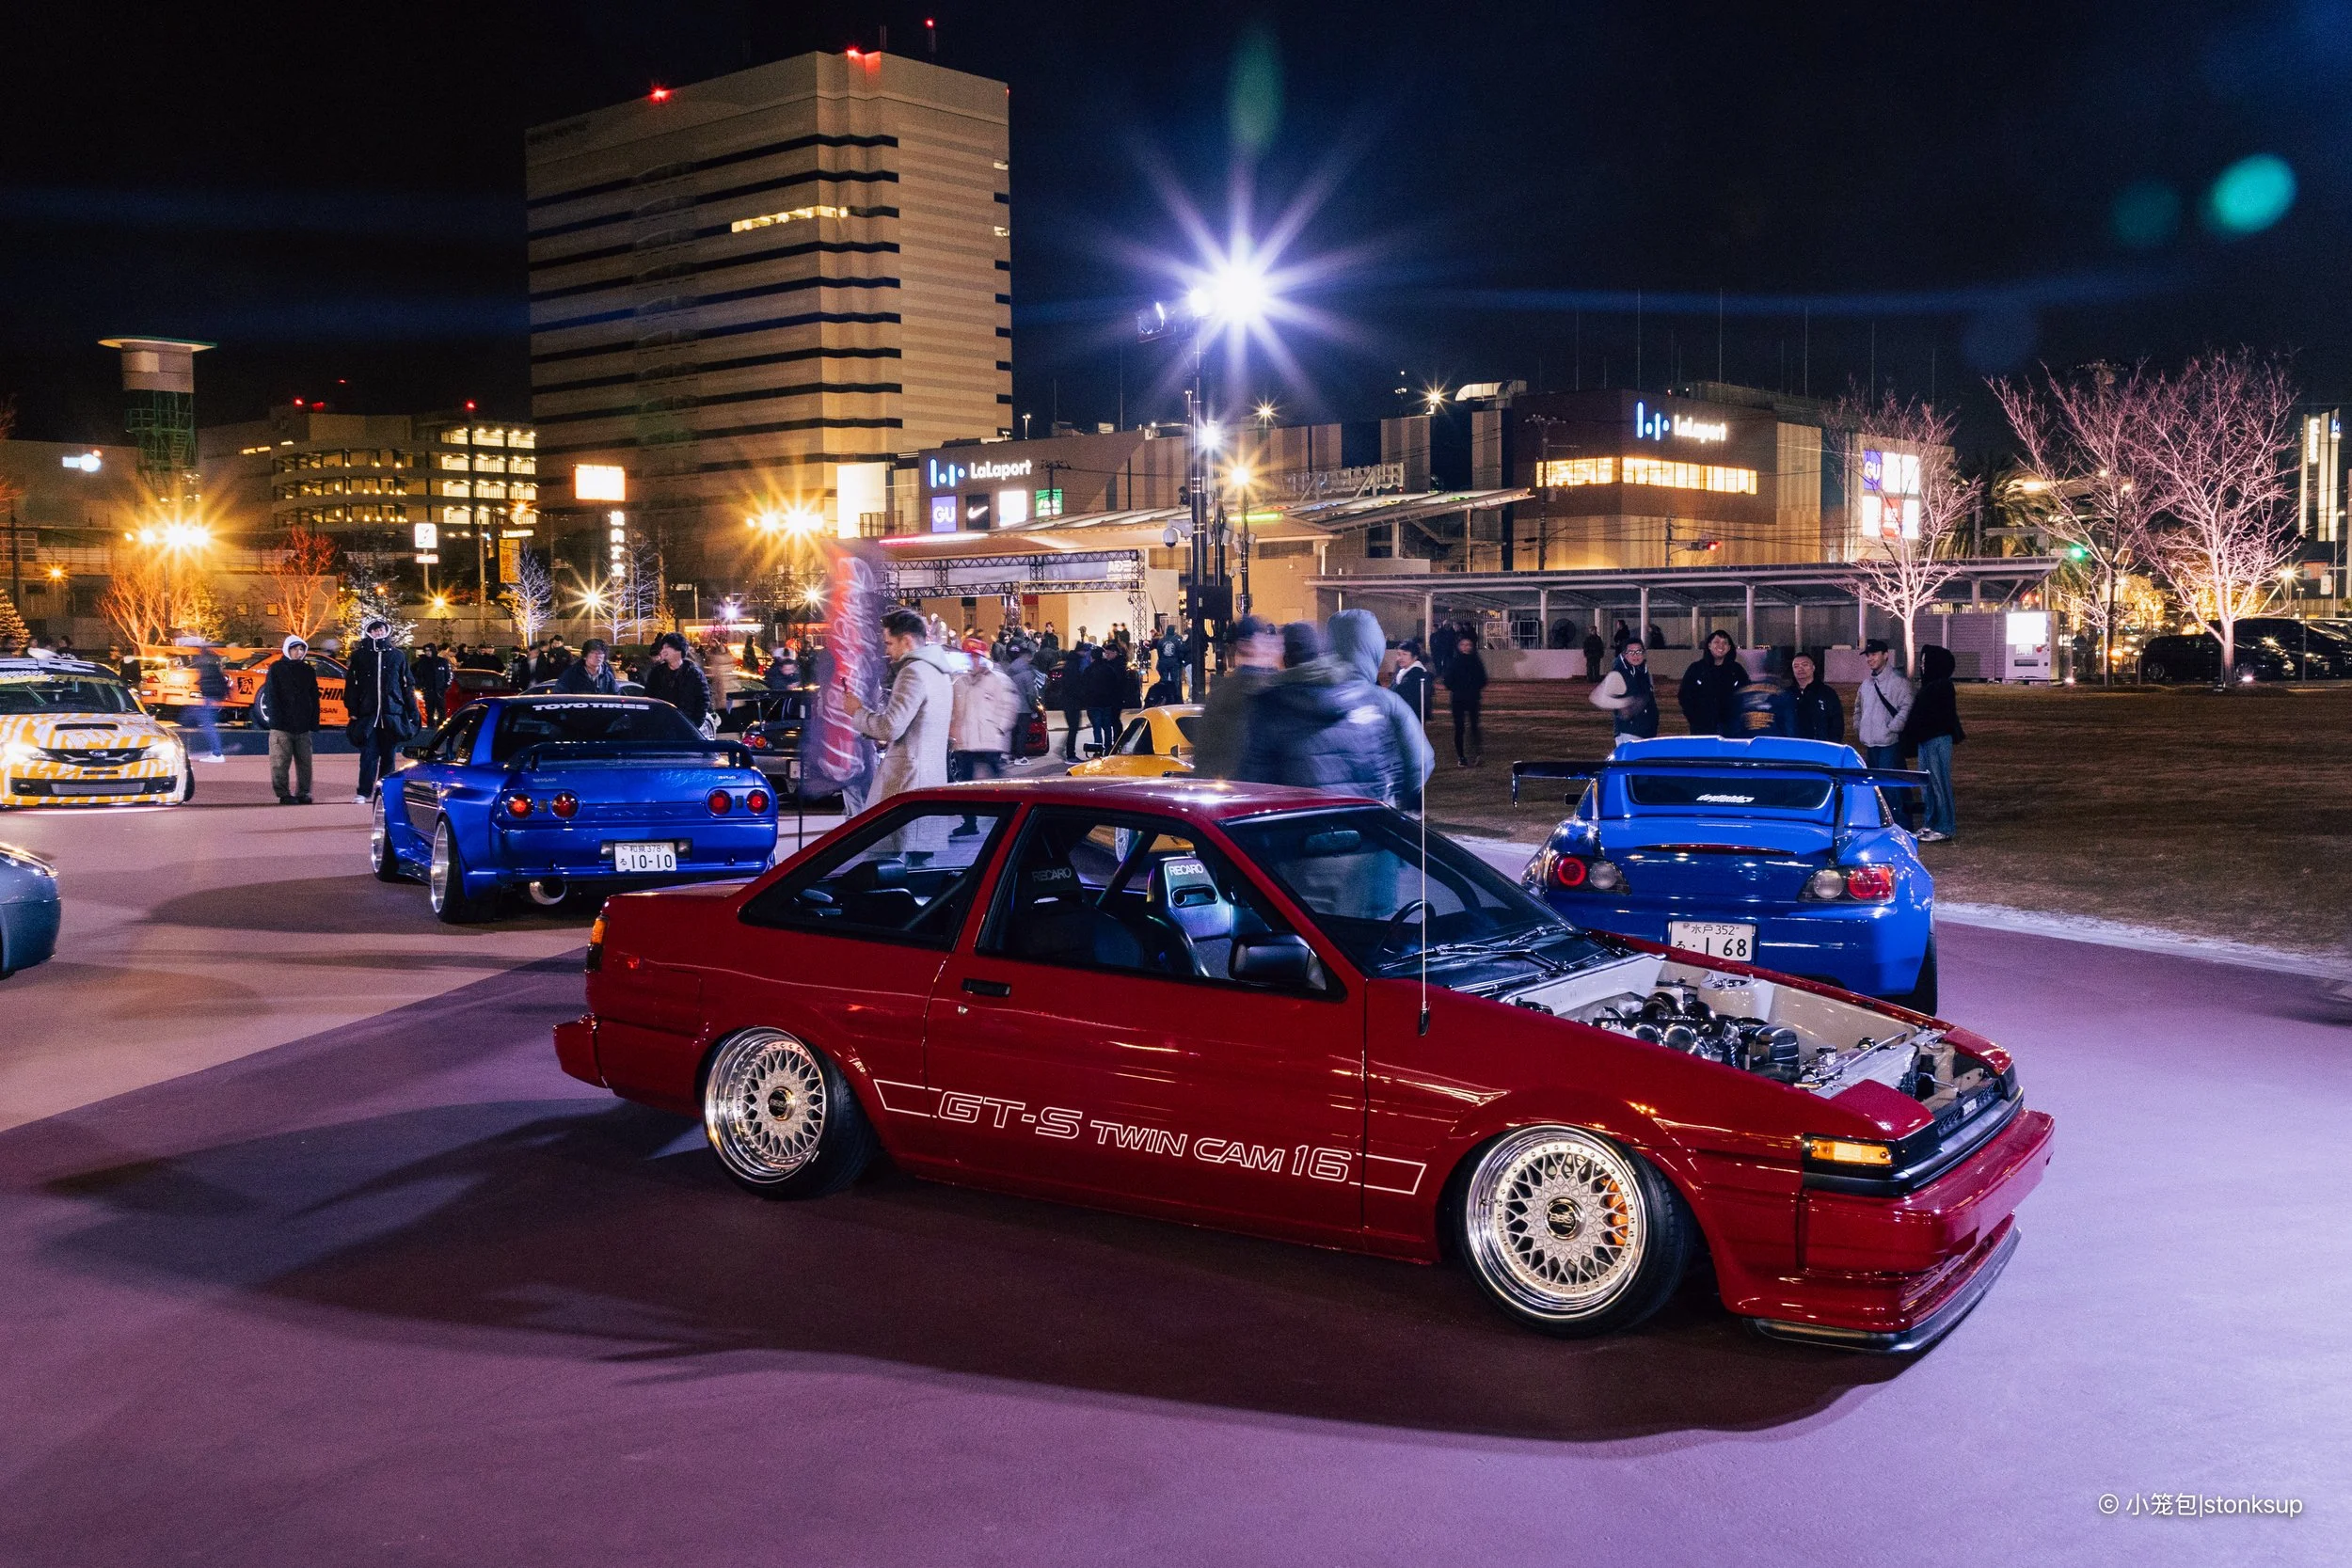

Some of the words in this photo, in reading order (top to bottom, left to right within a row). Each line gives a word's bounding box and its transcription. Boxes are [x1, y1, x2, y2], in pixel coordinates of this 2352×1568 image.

[971, 460, 1032, 480] LaLaport
[1864, 461, 1882, 480] GU
[932, 505, 956, 523] GU
[532, 703, 593, 711] TOYO
[631, 853, 673, 869] 10-10
[1168, 863, 1203, 876] RECARO
[1033, 867, 1073, 881] RECARO
[938, 1090, 1083, 1140] GT-S
[1089, 1119, 1188, 1158] TWIN
[1193, 1137, 1285, 1173] CAM
[1291, 1144, 1352, 1182] 16
